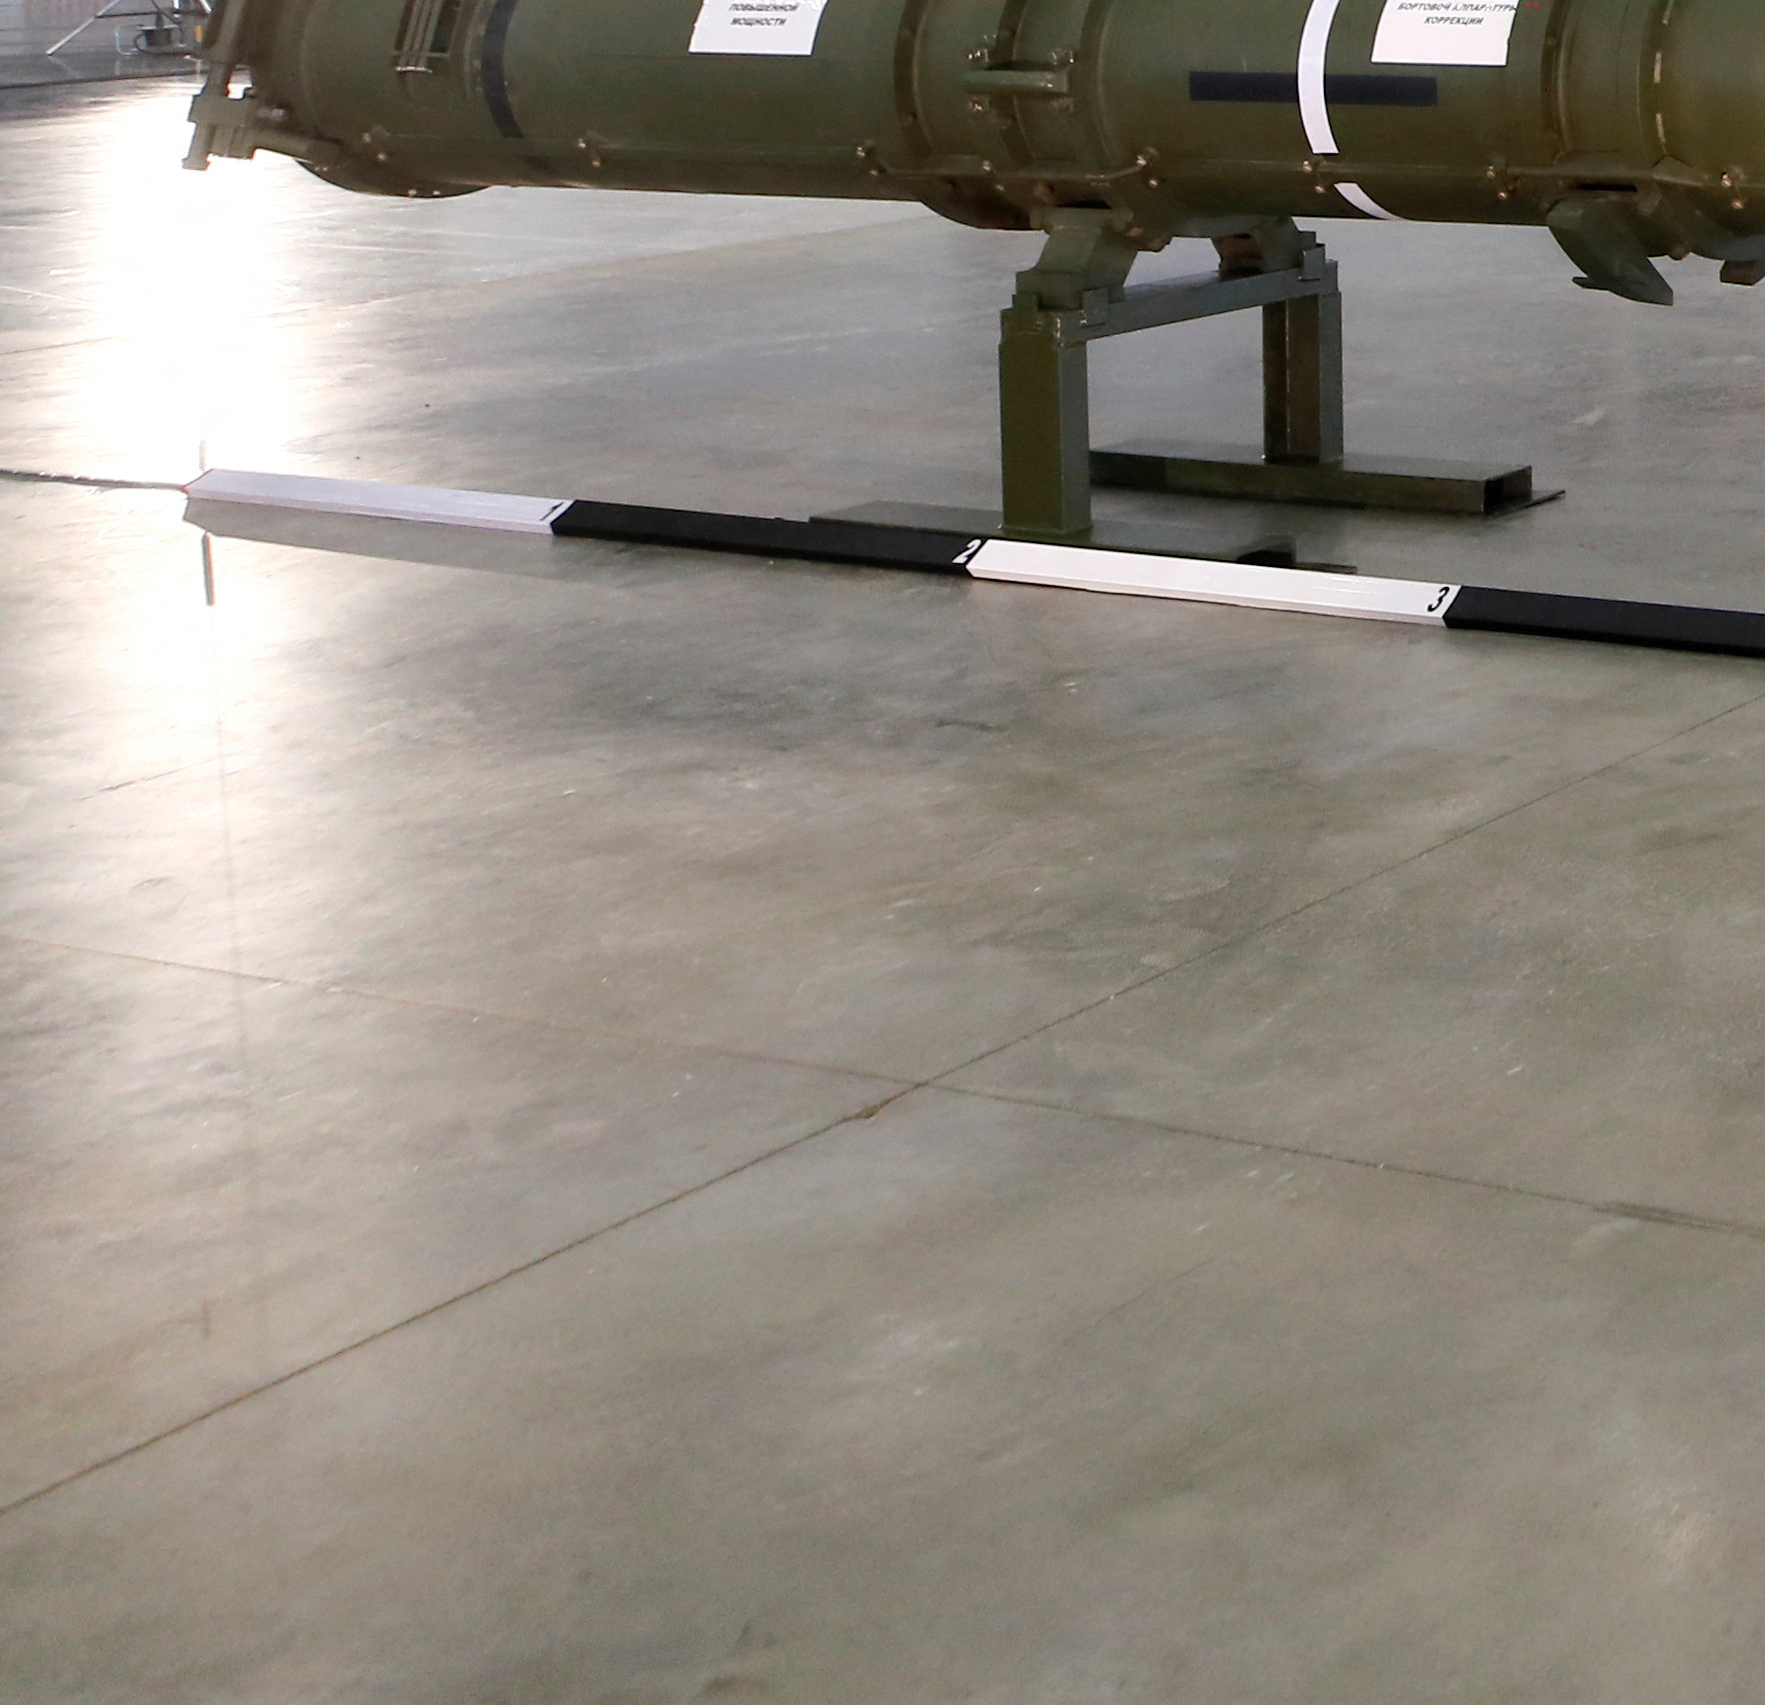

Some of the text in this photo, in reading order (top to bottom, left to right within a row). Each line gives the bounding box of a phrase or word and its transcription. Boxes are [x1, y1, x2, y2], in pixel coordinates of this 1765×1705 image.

[730, 17, 787, 27] МОЩНОСТИ
[1424, 16, 1484, 26] КОРРЕКЦИИ
[540, 500, 564, 521] 1
[952, 539, 981, 564] 2
[1427, 586, 1450, 612] 3
